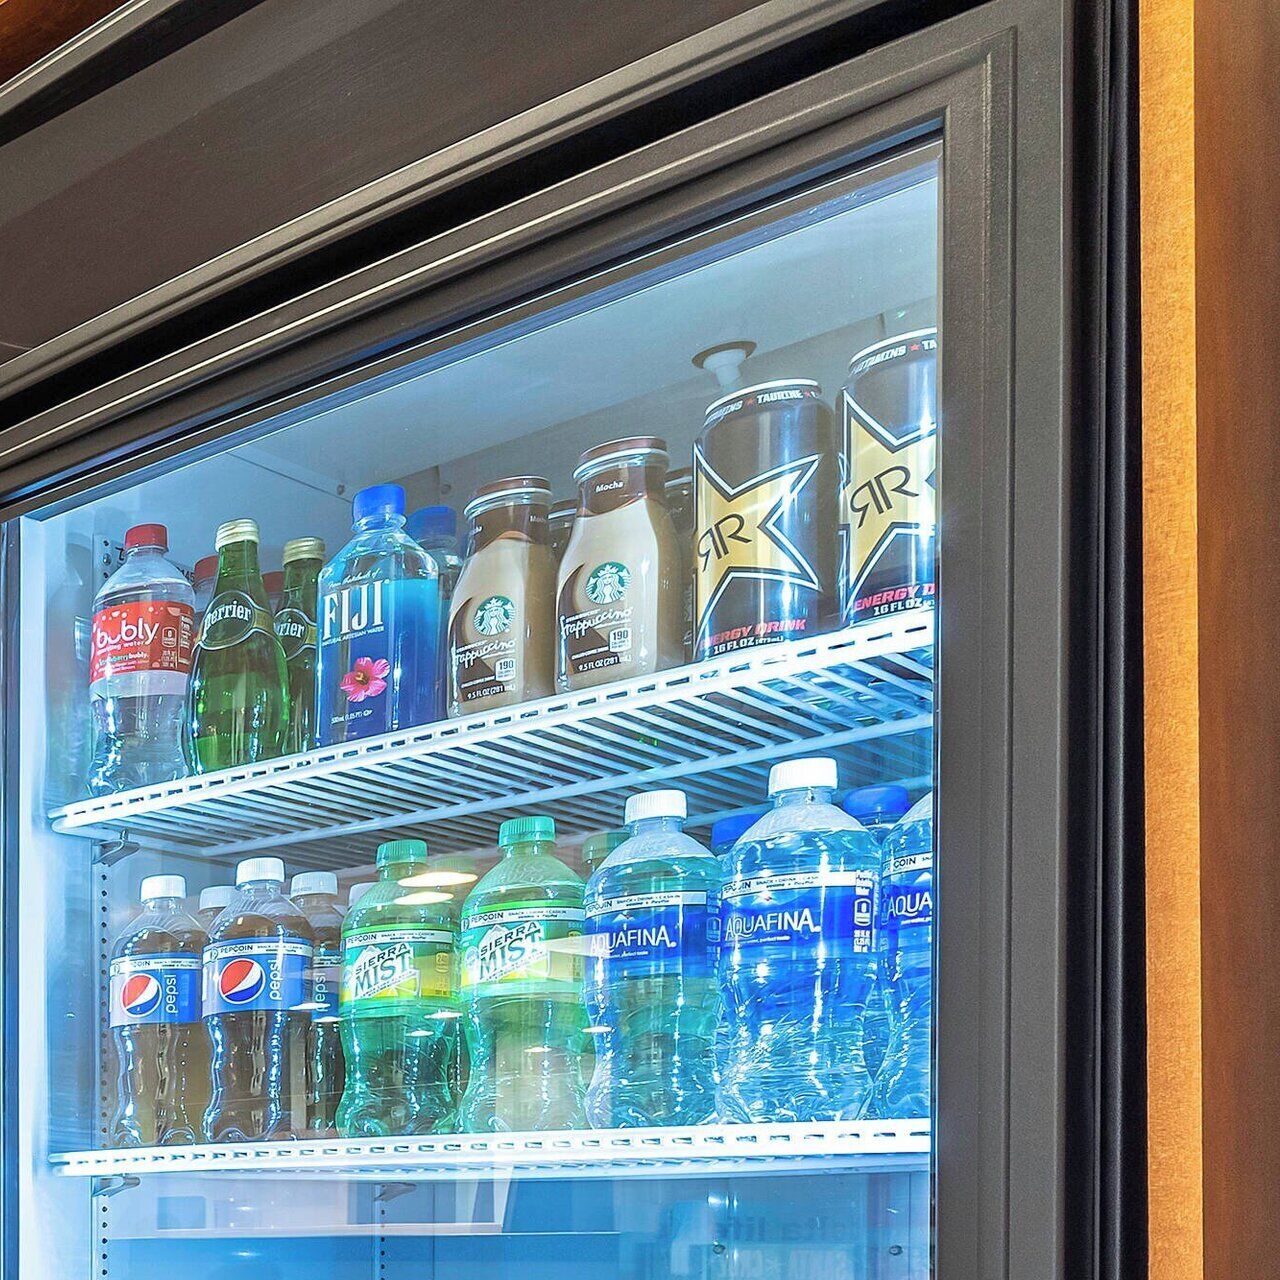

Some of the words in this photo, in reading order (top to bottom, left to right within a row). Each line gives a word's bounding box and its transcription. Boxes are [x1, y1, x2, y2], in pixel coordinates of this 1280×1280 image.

[757, 390, 804, 404] TAURINE
[596, 480, 624, 493] Mocha
[322, 580, 384, 640] FIJI
[96, 617, 159, 650] bubly
[613, 631, 628, 641] 190
[755, 619, 806, 636] DRINK
[499, 660, 513, 670] 190
[471, 913, 503, 924] PEPCOIN
[726, 907, 816, 941] AQUAFINA
[221, 945, 254, 954] PEPCOIN
[347, 933, 377, 943] PEPCOIN
[480, 922, 538, 953] SIERRA
[590, 925, 671, 954] AQUAFINA
[356, 943, 407, 973] SIERRA
[478, 929, 542, 979] MIST
[268, 959, 283, 1001] pepsi
[354, 950, 412, 998] MIST
[164, 974, 178, 1014] pepsi
